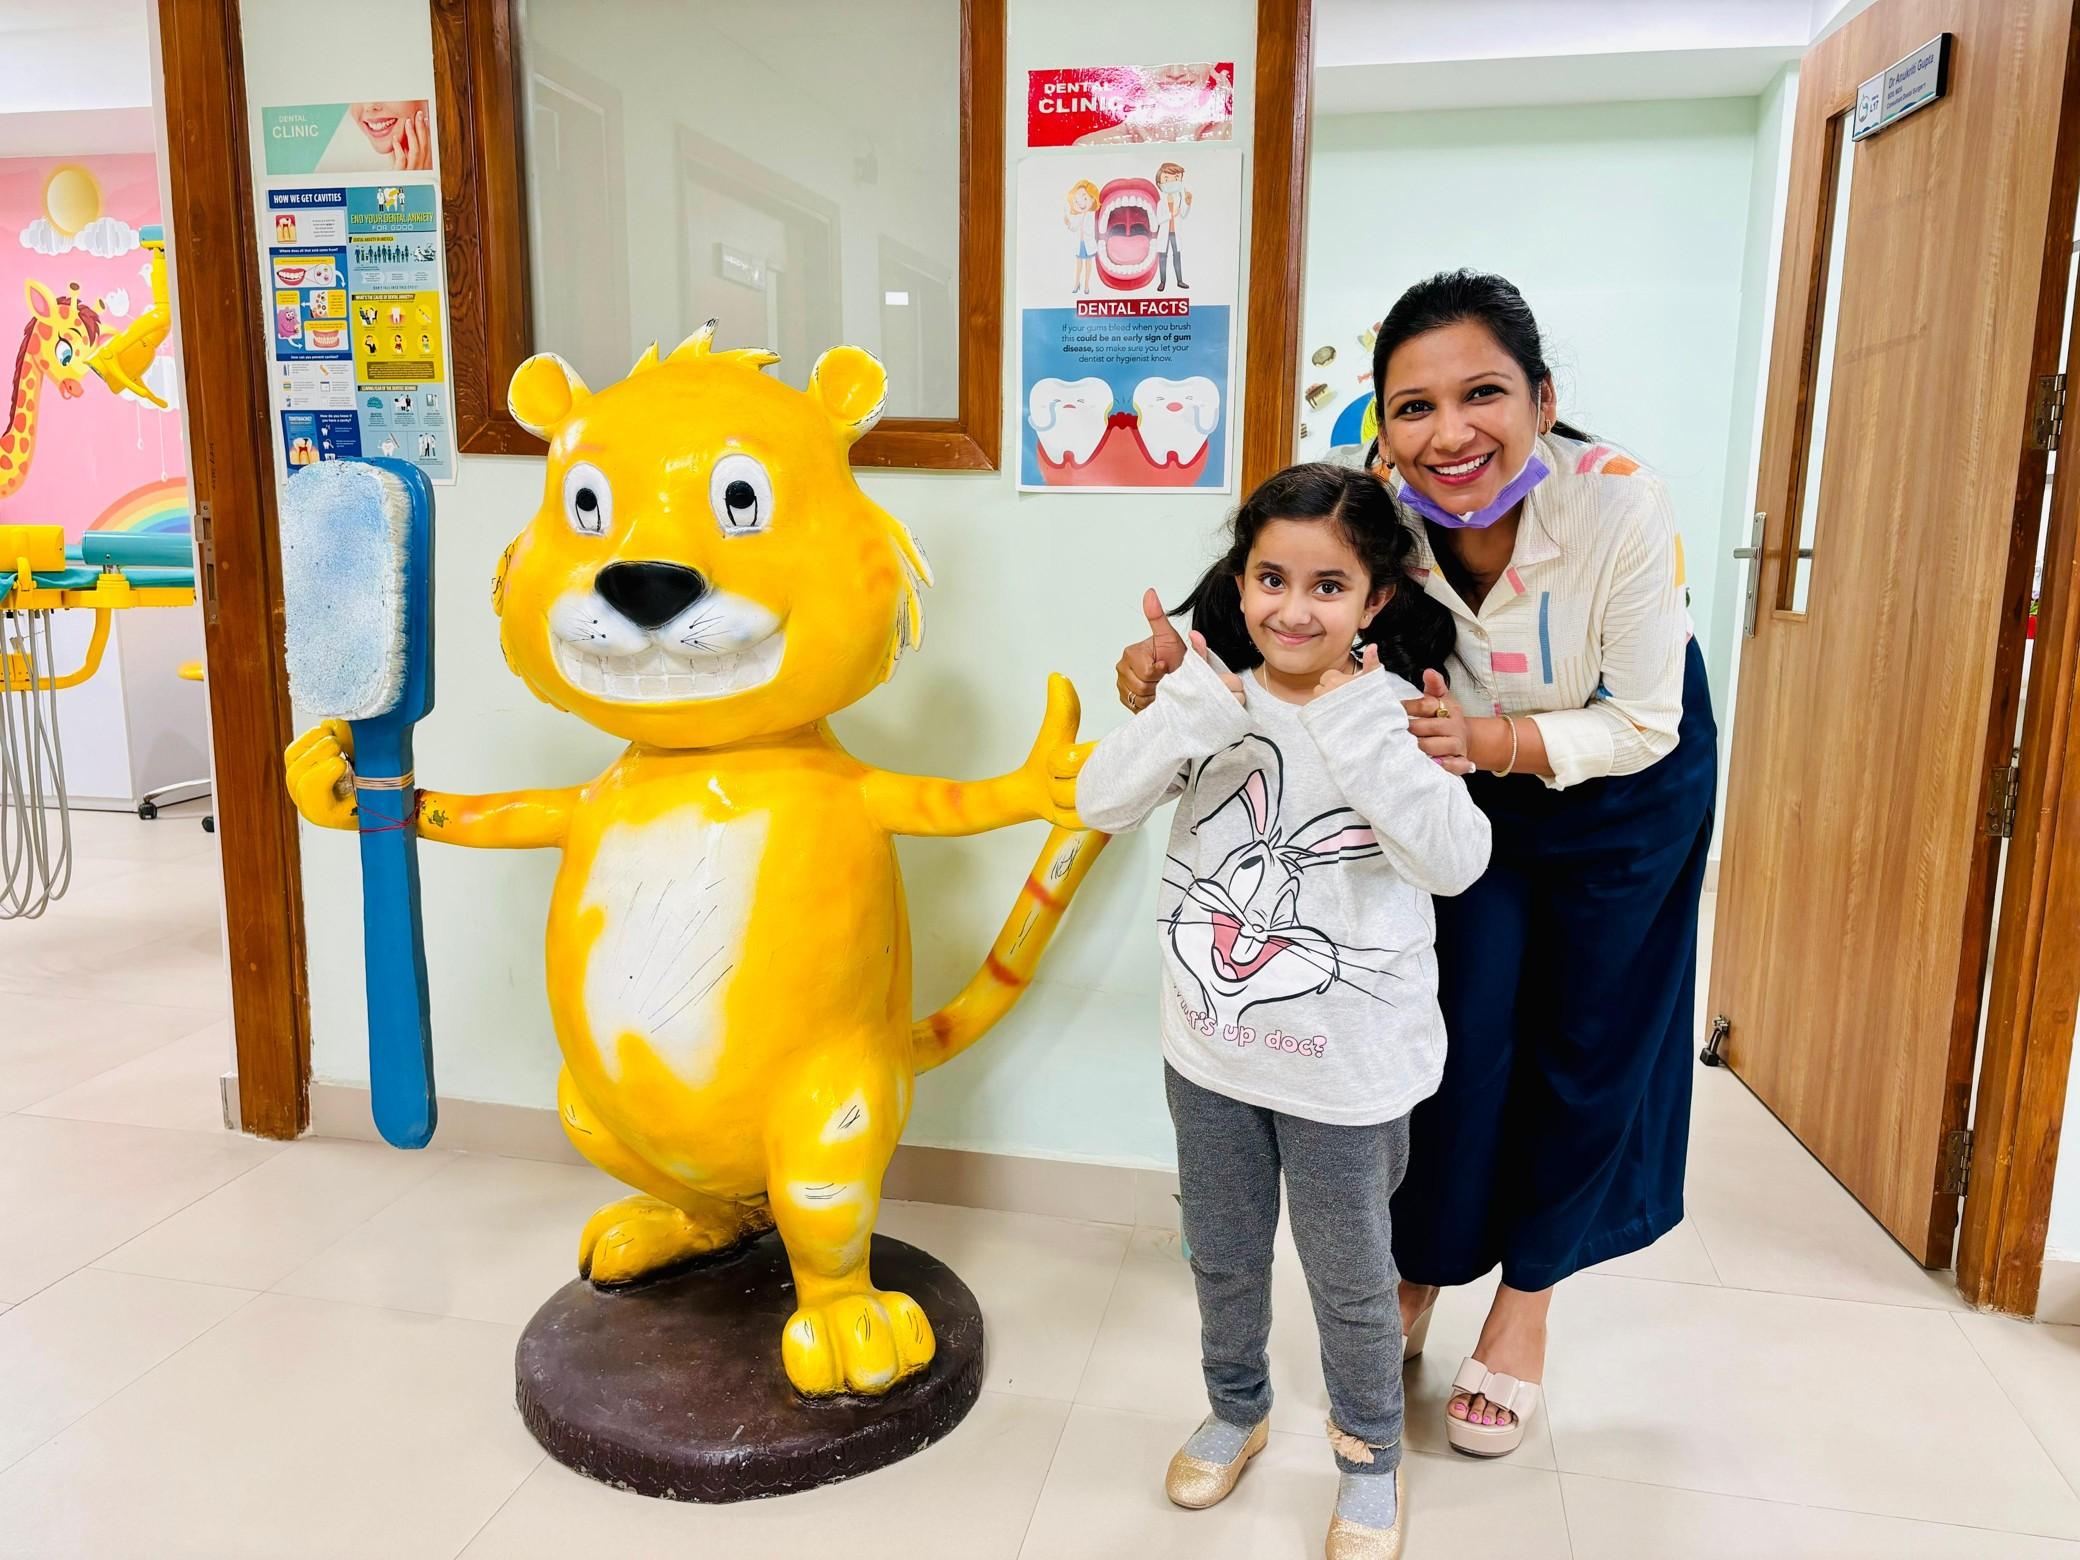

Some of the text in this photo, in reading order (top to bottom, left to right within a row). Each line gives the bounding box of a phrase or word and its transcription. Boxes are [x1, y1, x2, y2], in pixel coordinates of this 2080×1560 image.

[1917, 54, 1934, 71] Gupta
[1044, 82, 1112, 94] DENTAL
[1038, 96, 1122, 114] CLINIC
[278, 114, 307, 122] DENTAL
[272, 124, 319, 138] CLINIC
[274, 193, 342, 204] HOW WE GET CAVITIES
[364, 214, 382, 224] YOUR
[383, 212, 408, 224] DENTAL
[408, 212, 433, 223] ANXIETY
[1078, 301, 1188, 316] DENTAL FACTS
[1108, 323, 1130, 331] bleed
[1154, 324, 1168, 332] you
[1170, 323, 1191, 331] brush
[1062, 334, 1075, 342] this
[1077, 334, 1097, 342] could
[1123, 334, 1142, 343] early
[1144, 334, 1160, 343] sign
[1173, 334, 1191, 343] gum
[1063, 344, 1094, 354] disease,
[1144, 345, 1159, 353] you
[1172, 345, 1189, 353] your
[1116, 355, 1149, 364] hygienist
[1223, 1024, 1256, 1047] up
[1264, 1030, 1328, 1058] doc?
